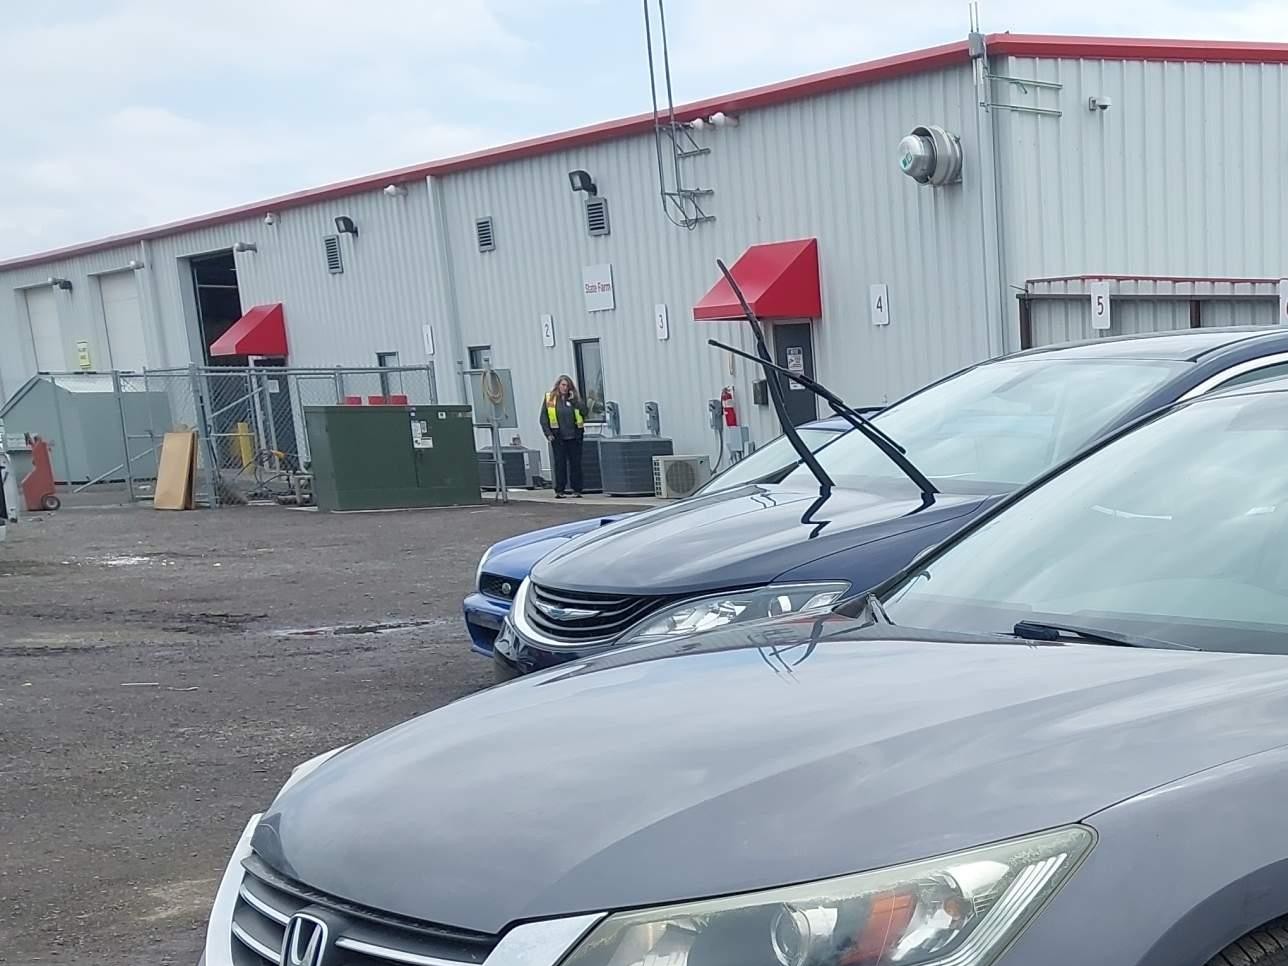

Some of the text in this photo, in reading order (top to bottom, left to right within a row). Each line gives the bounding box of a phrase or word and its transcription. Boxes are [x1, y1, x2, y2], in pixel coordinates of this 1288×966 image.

[598, 281, 611, 292] Farm
[875, 295, 883, 313] 4
[1097, 296, 1104, 316] 5
[658, 314, 664, 329] 3
[544, 323, 551, 338] 2
